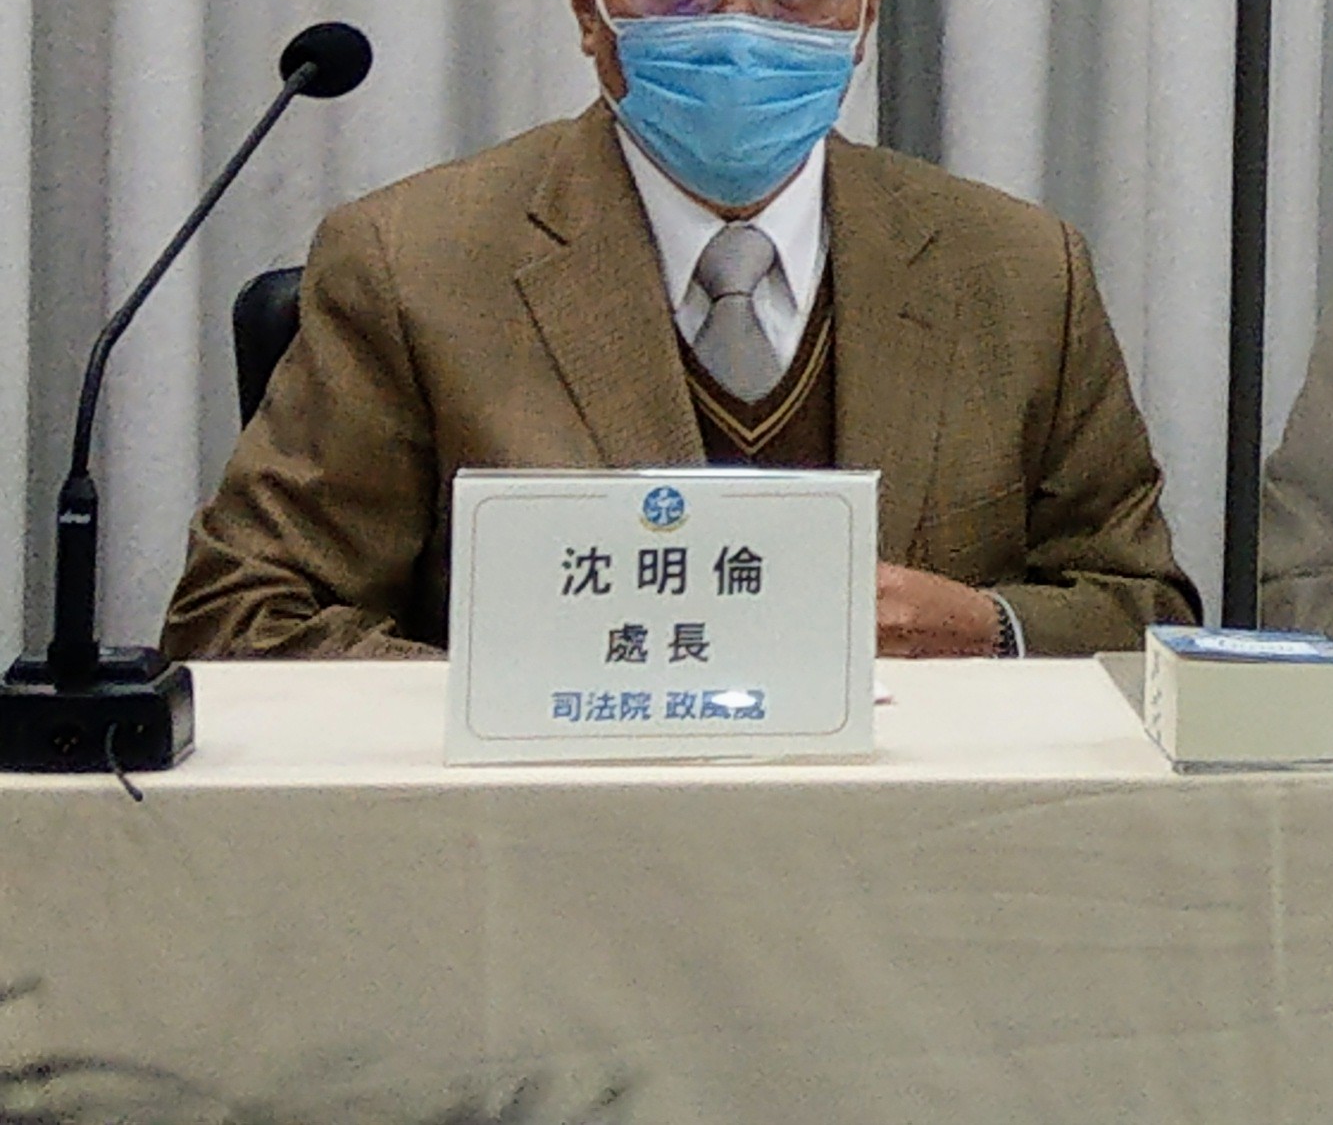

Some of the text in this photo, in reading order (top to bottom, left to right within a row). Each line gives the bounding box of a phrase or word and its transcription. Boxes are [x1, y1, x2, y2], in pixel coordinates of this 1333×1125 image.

[561, 545, 764, 597] 沈明倫
[605, 622, 711, 665] 處長
[551, 691, 653, 723] 司法院
